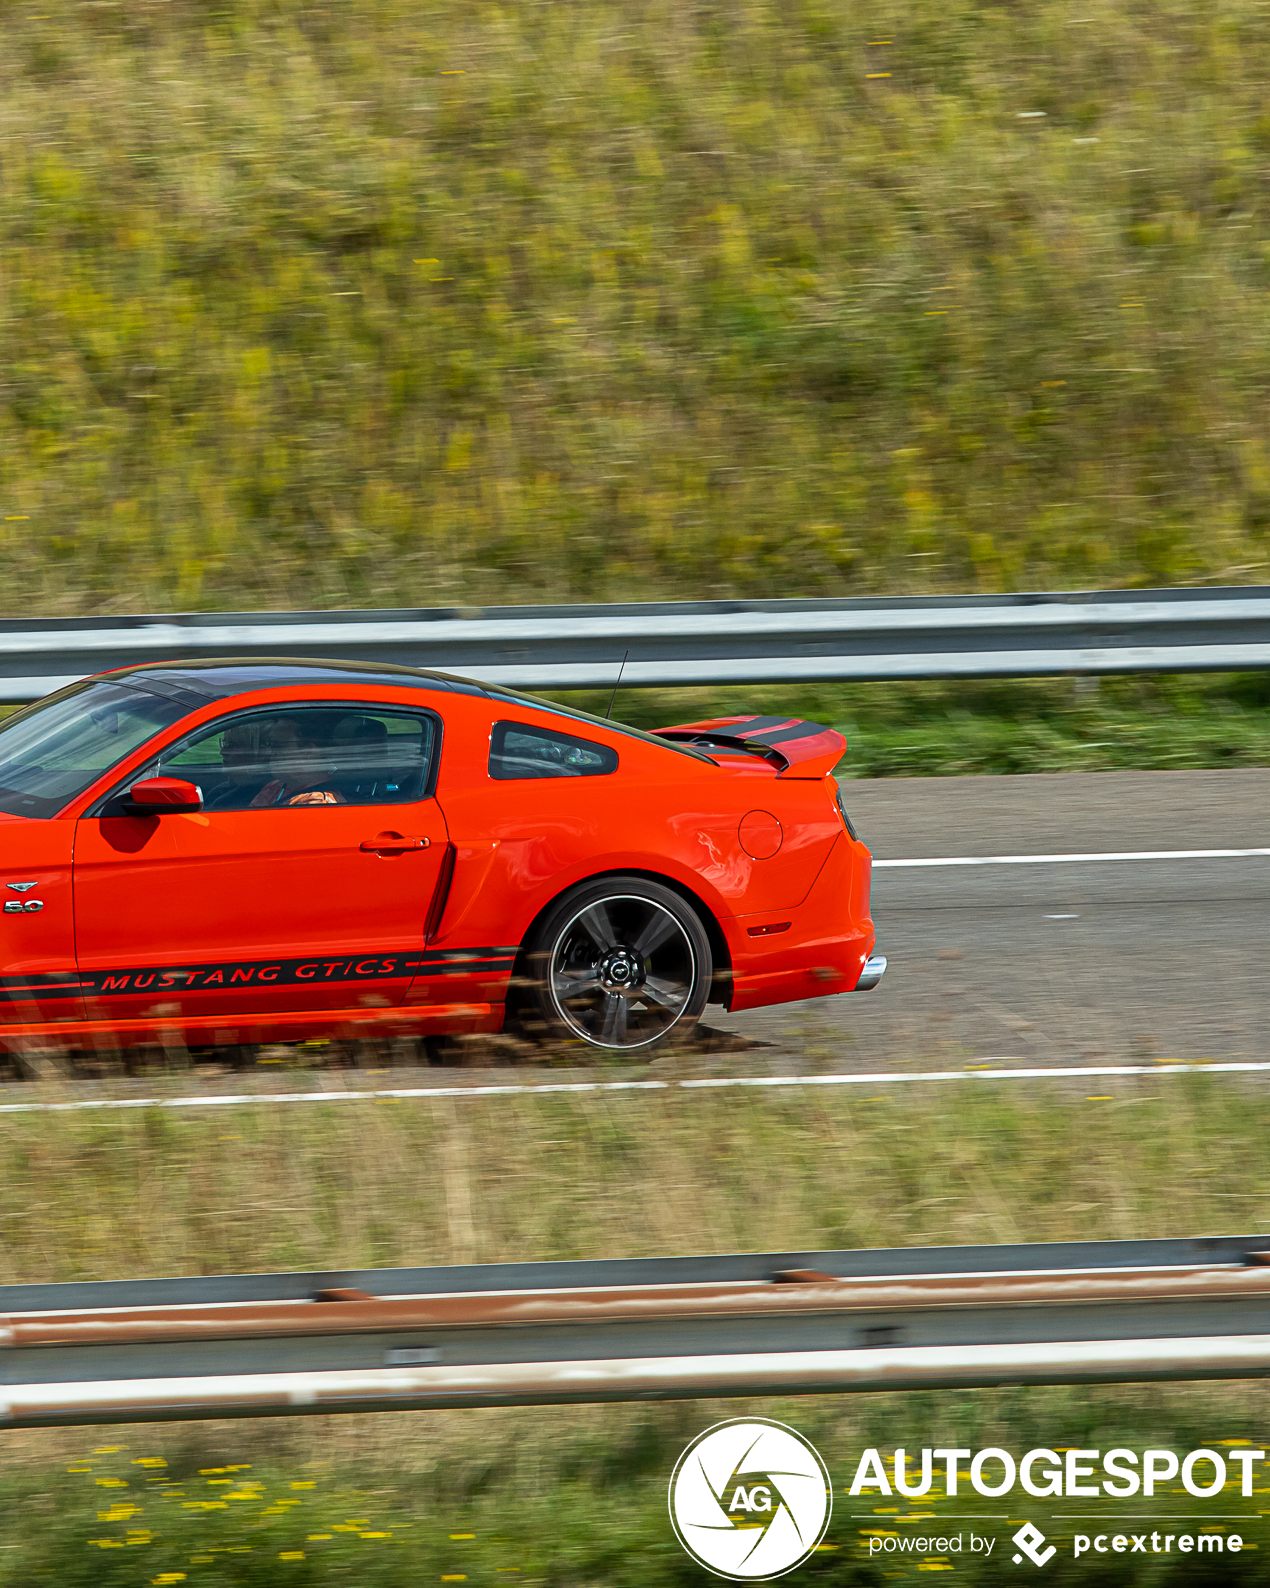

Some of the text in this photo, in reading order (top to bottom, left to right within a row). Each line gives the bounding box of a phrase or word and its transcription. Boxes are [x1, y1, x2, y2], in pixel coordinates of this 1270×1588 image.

[4, 900, 44, 913] 5.0
[101, 959, 397, 990] MUSTANG GT/CS
